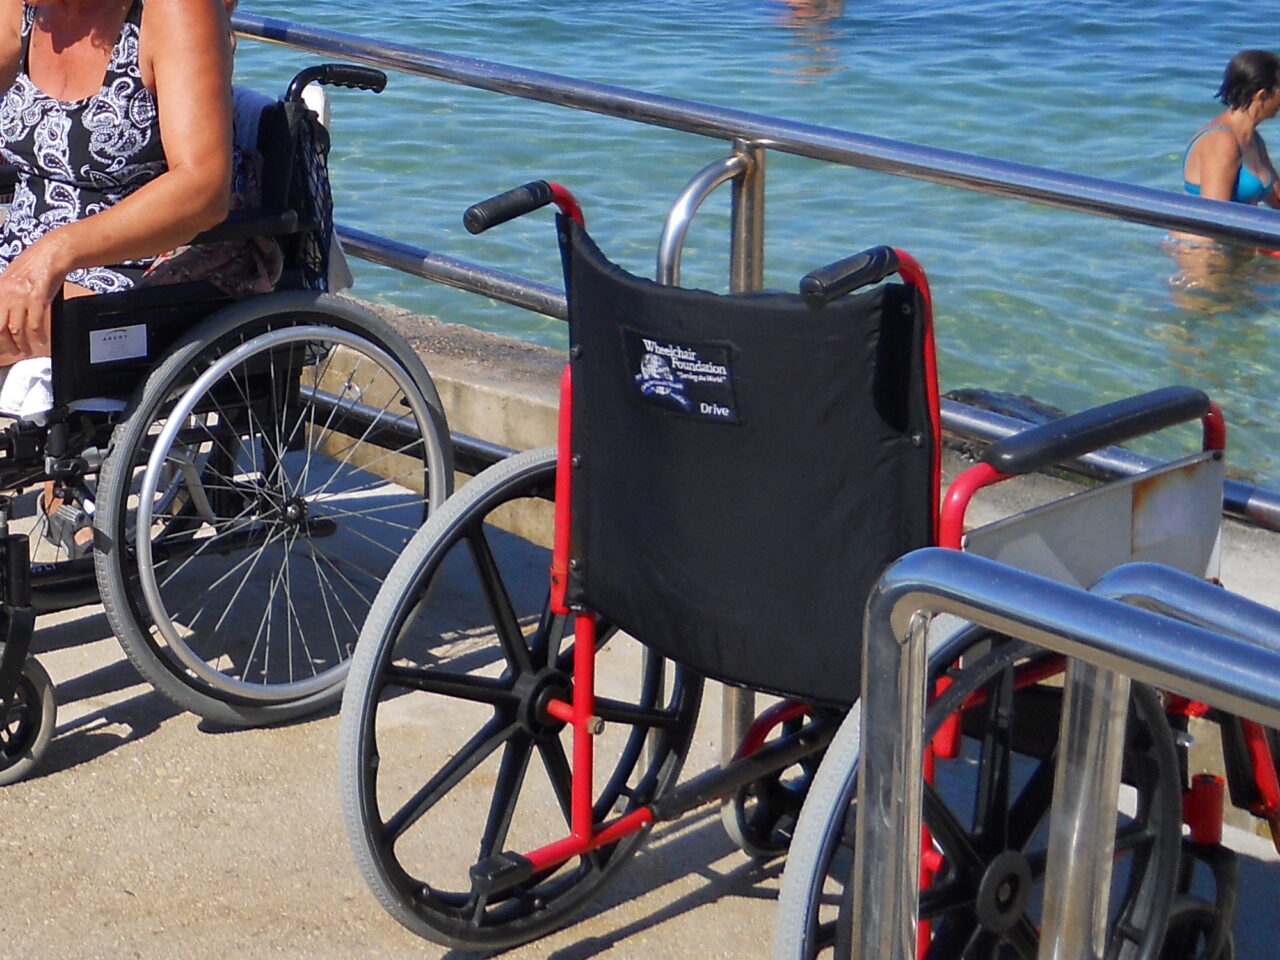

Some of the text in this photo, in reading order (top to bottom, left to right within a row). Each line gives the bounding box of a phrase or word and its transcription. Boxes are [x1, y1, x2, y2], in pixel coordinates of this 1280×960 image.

[642, 339, 697, 360] Wheelchair
[671, 357, 727, 375] Foundation
[700, 402, 730, 416] Drive
